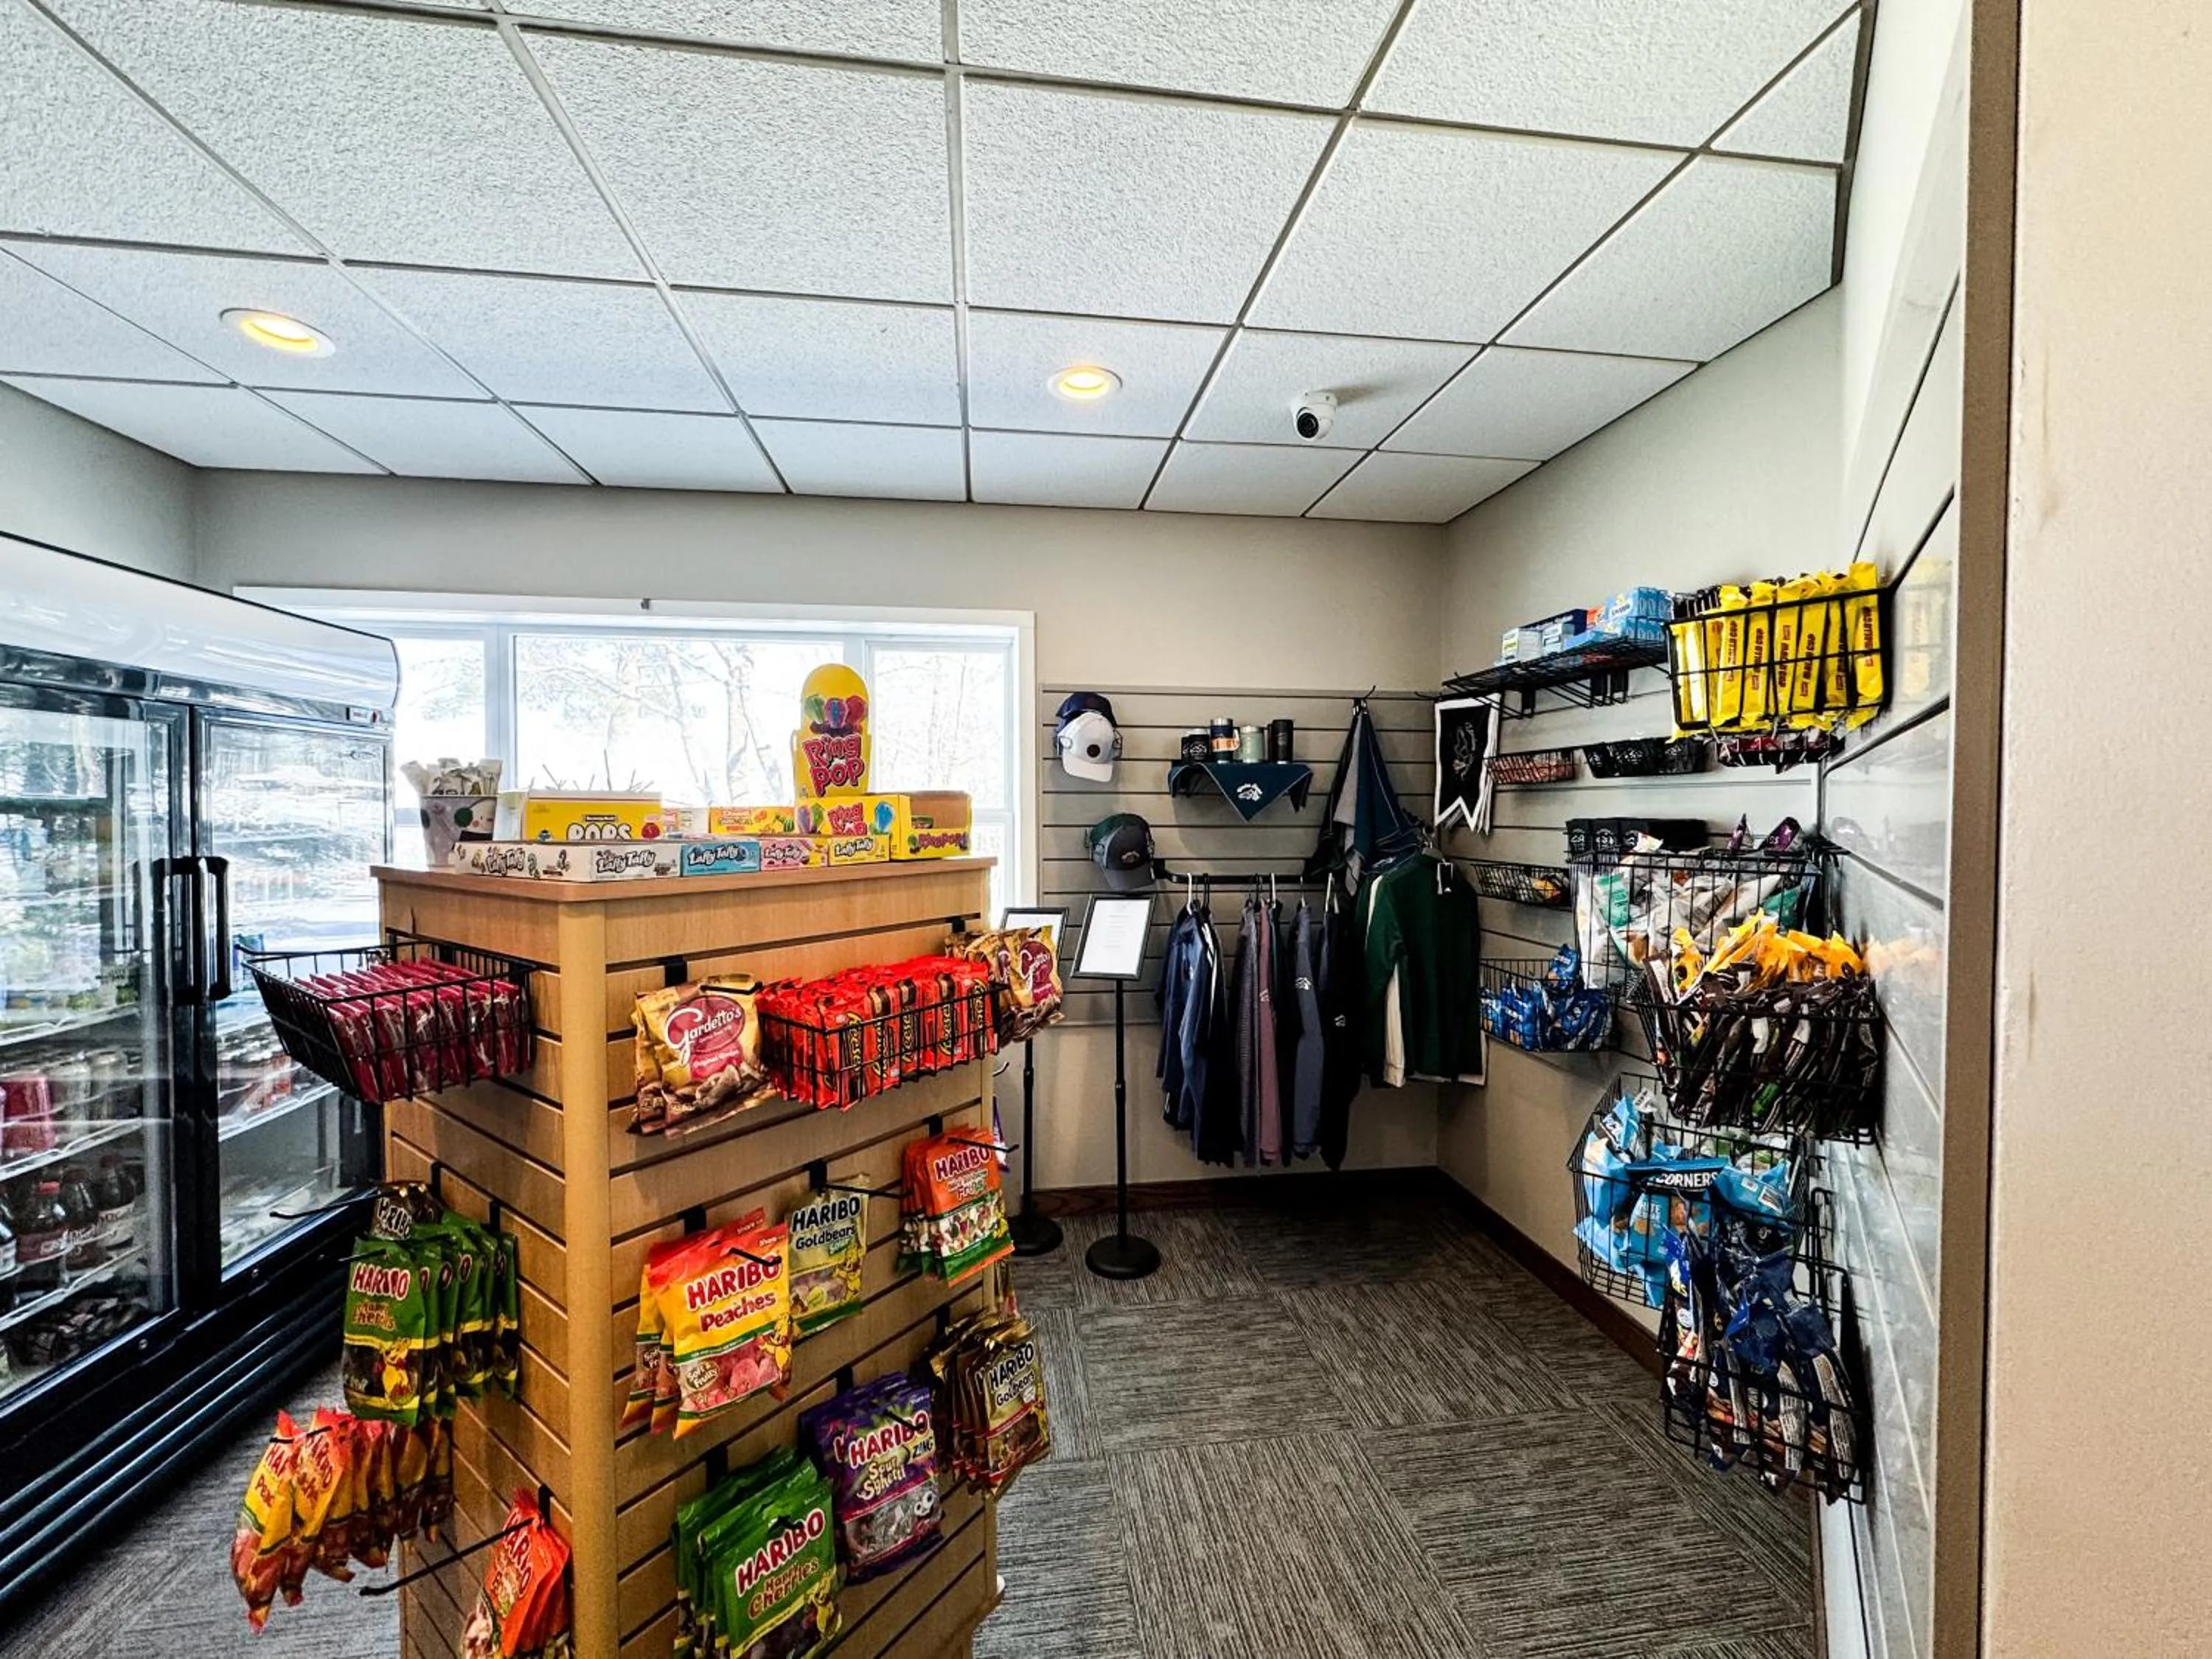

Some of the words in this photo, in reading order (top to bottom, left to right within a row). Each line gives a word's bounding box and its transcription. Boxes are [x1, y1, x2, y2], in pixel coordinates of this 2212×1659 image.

[802, 734, 861, 768] Ring
[596, 855, 626, 874] Laffy
[625, 849, 655, 868] Taffy
[688, 849, 716, 866] Laffy
[714, 844, 739, 860] Taffy
[834, 843, 856, 858] Laffy
[664, 1007, 742, 1066] Gardetto's
[792, 1197, 860, 1232] HARIBO
[796, 1225, 856, 1250] Goldbears
[686, 1255, 780, 1311] HARIBO
[700, 1293, 776, 1332] Peaches
[849, 1413, 928, 1468] HARIBO
[869, 1456, 897, 1480] Sour
[737, 1509, 825, 1596] HARIBO
